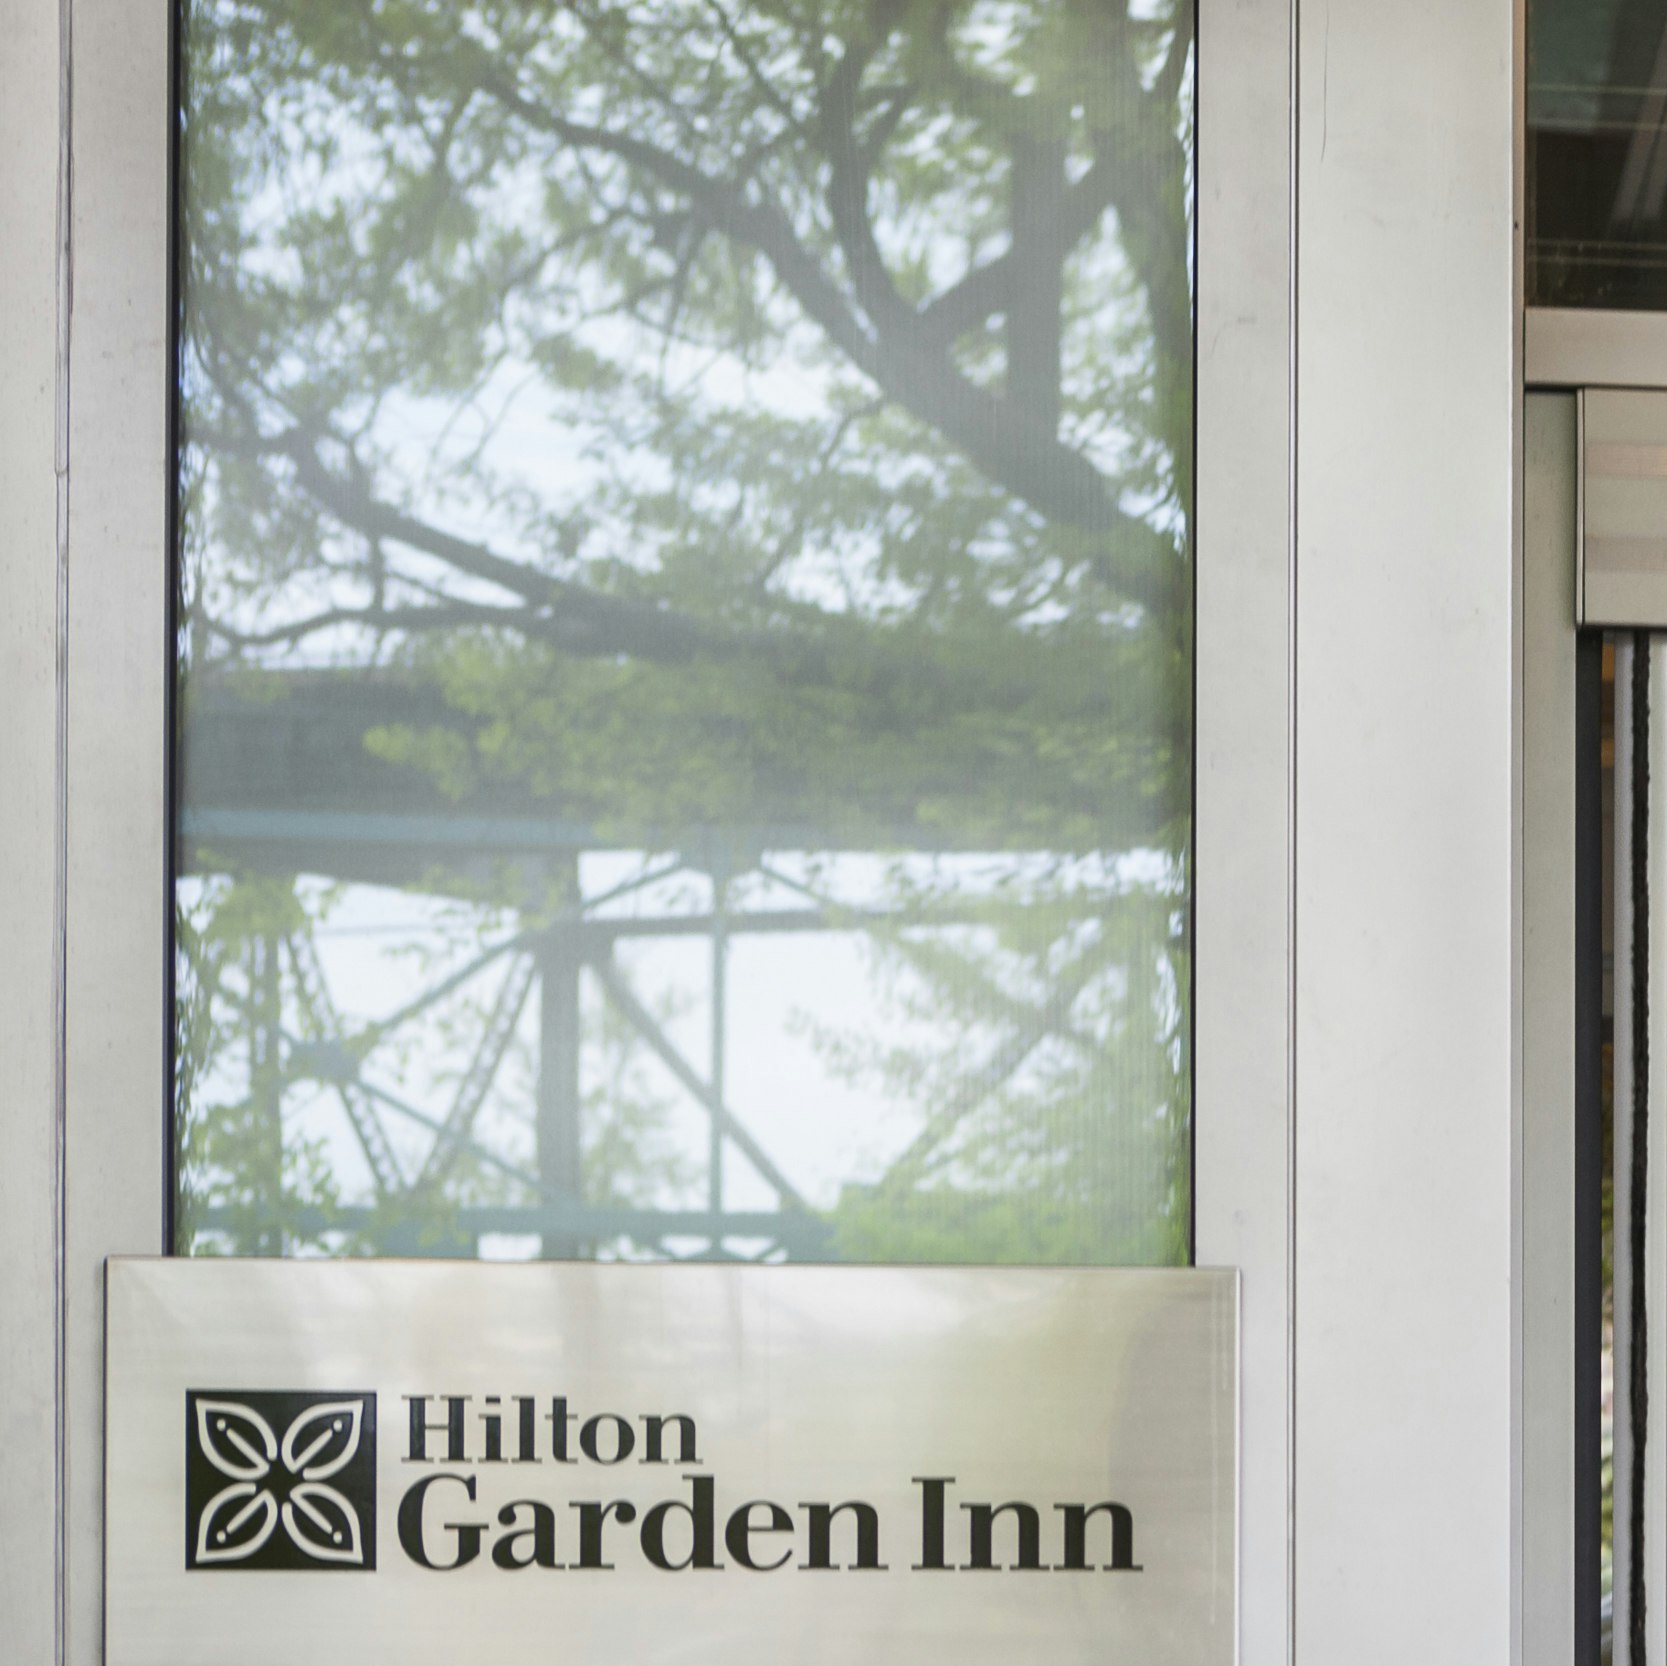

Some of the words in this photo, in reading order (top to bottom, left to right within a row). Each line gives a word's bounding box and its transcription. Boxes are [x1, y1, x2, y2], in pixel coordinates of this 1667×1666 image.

[401, 1394, 703, 1465] Hilton
[398, 1474, 888, 1571] Garden
[912, 1478, 1143, 1571] Inn
